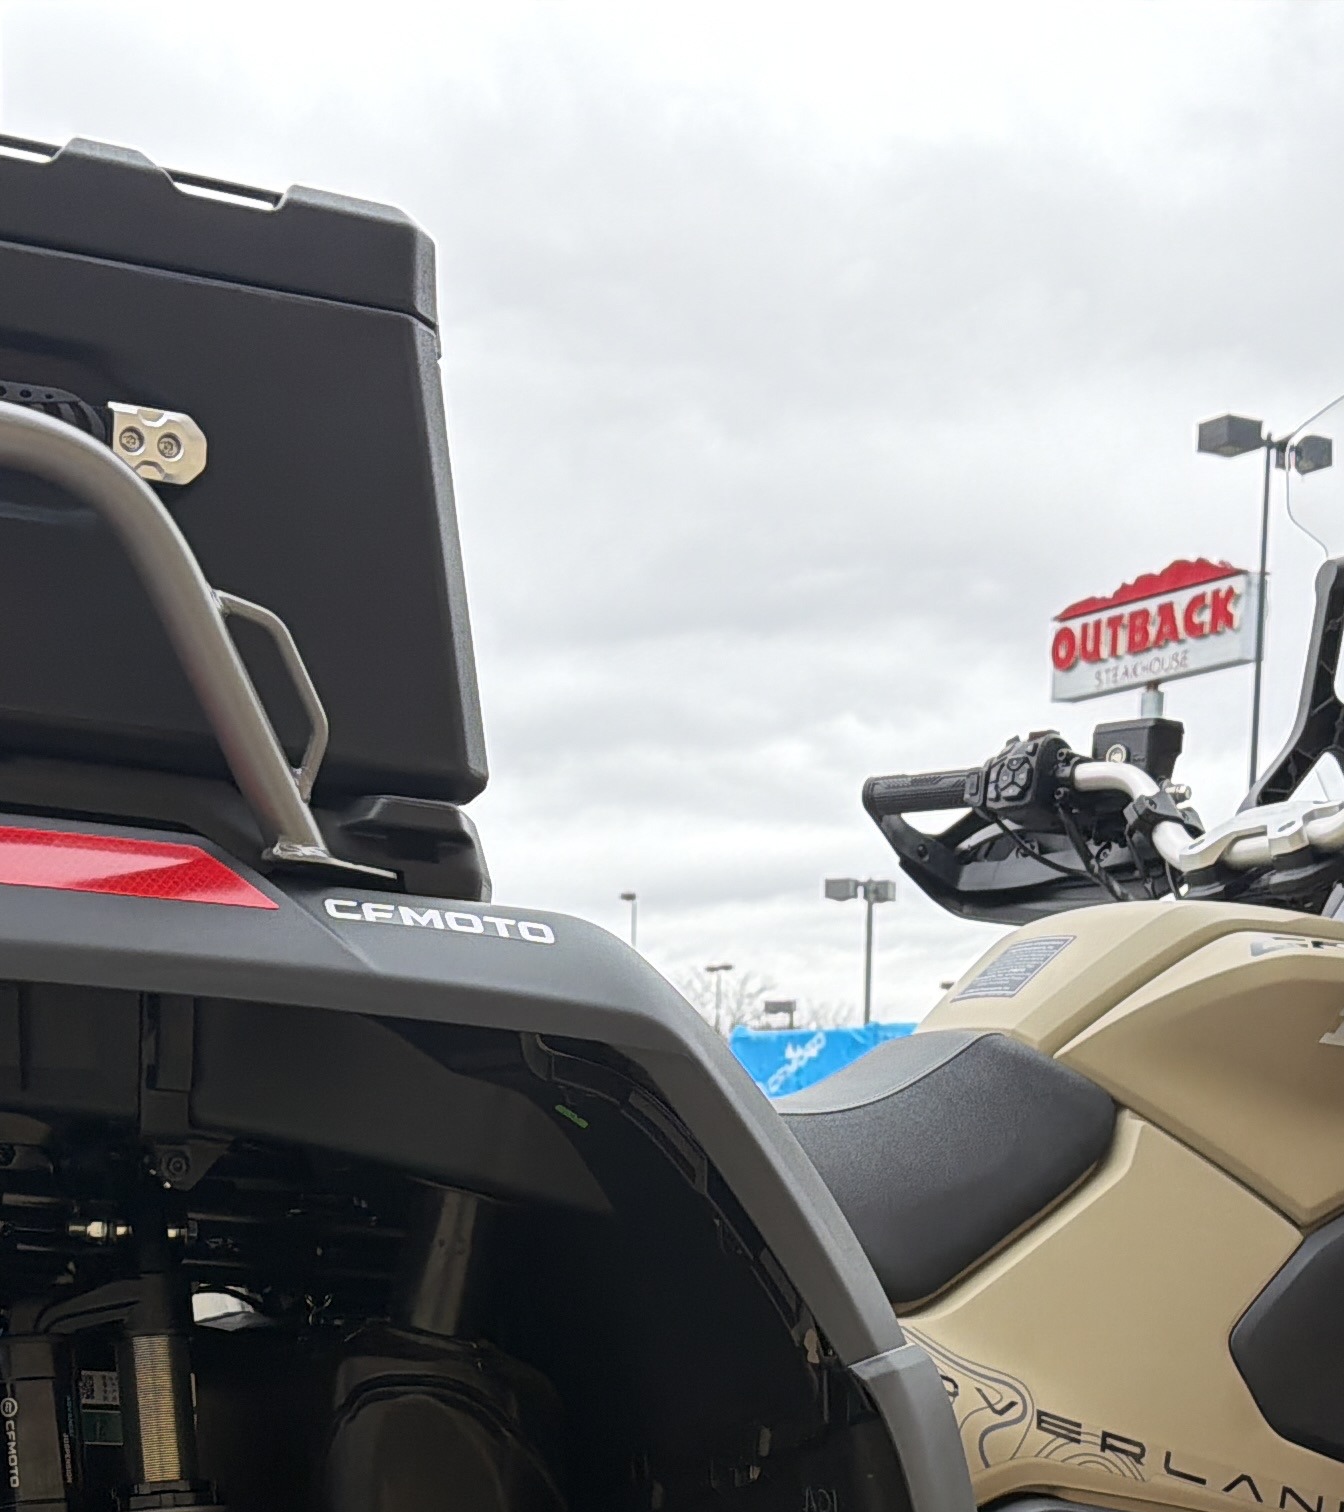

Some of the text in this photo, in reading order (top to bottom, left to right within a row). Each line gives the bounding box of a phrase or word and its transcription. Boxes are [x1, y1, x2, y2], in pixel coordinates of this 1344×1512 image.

[1052, 585, 1239, 672] OUTBACK
[1094, 650, 1189, 690] STEAKHOUSE
[324, 898, 555, 945] CFMOTO
[5, 1420, 20, 1488] CFMOTO
